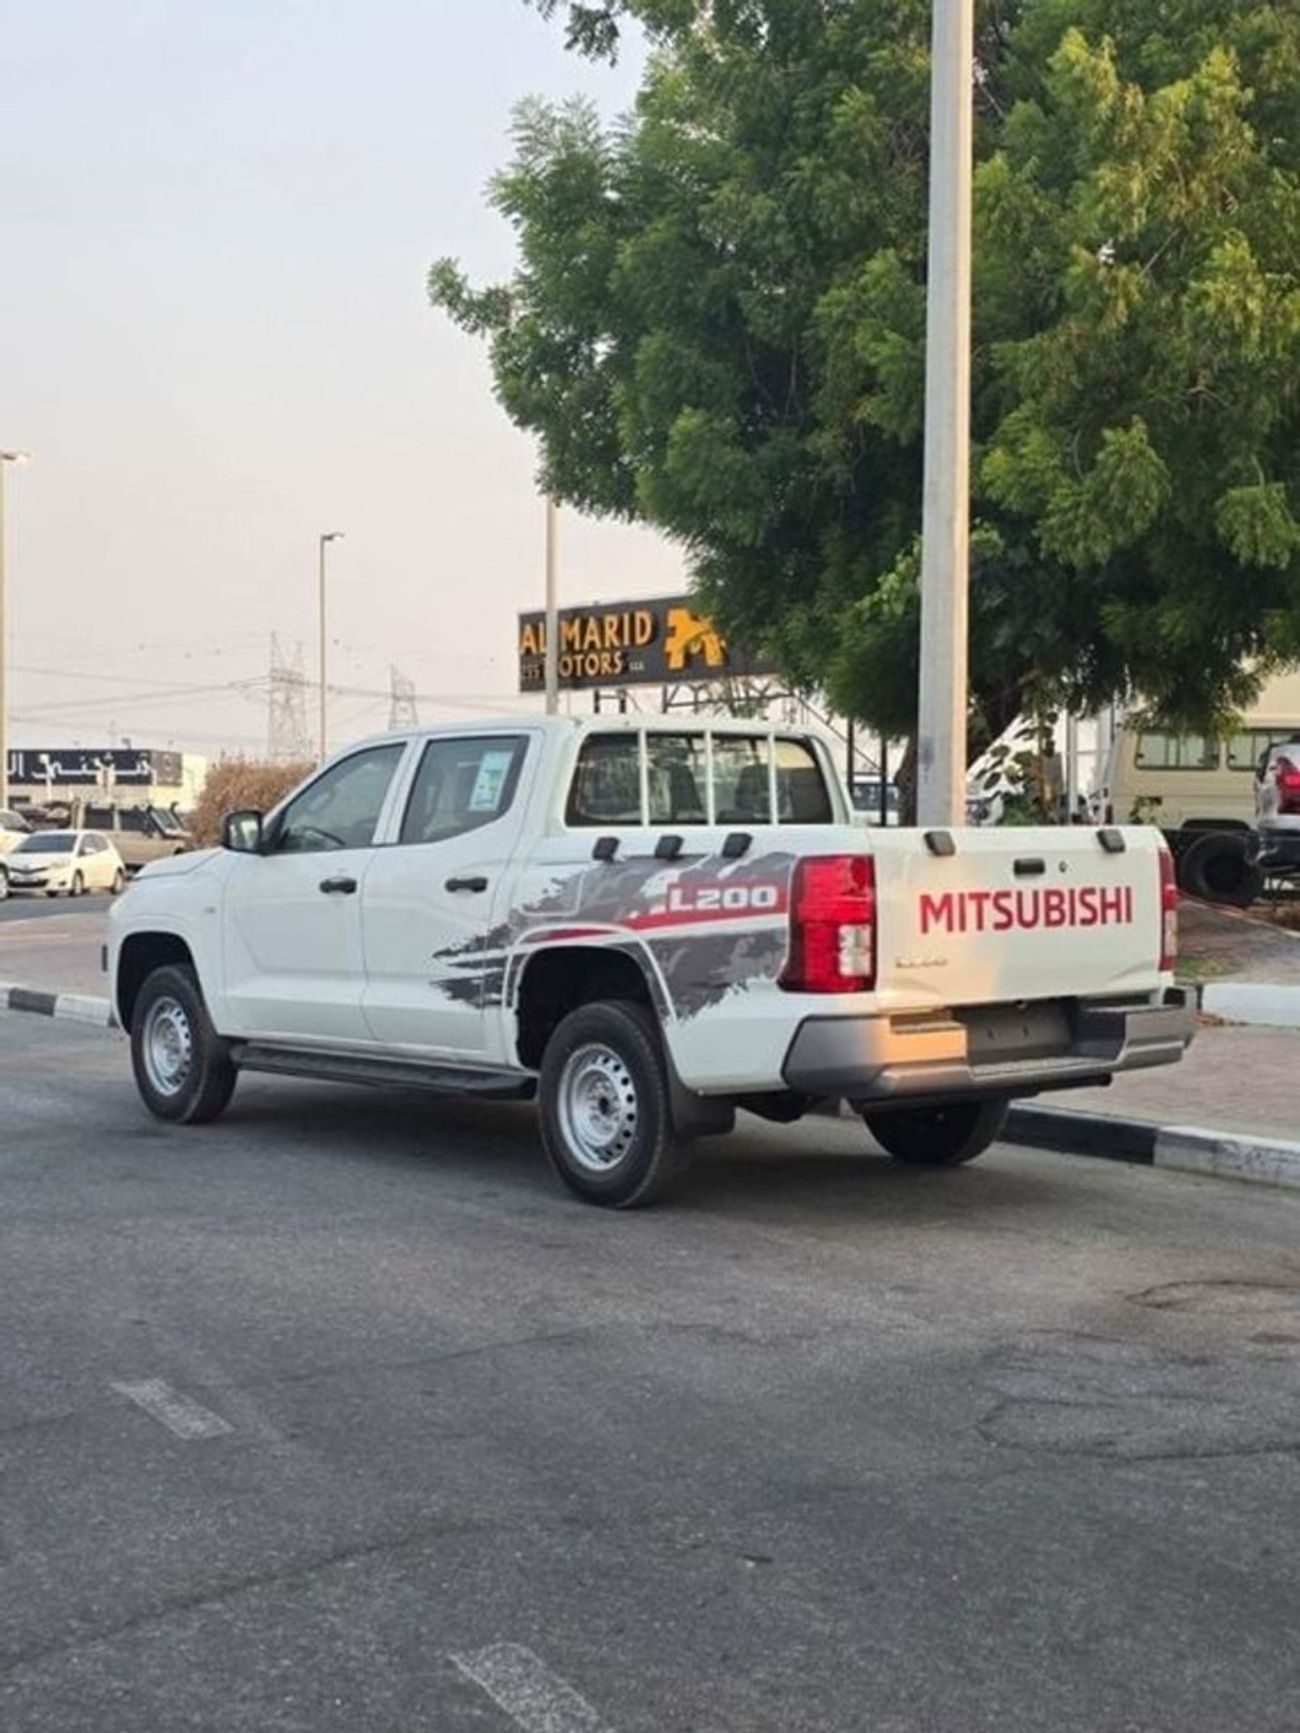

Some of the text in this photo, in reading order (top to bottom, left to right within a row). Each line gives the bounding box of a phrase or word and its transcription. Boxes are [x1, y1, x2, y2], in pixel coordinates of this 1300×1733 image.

[560, 611, 652, 651] MARID
[544, 651, 622, 678] OTORS
[669, 885, 777, 912] L200
[919, 886, 1133, 935] MITSUBISHI
